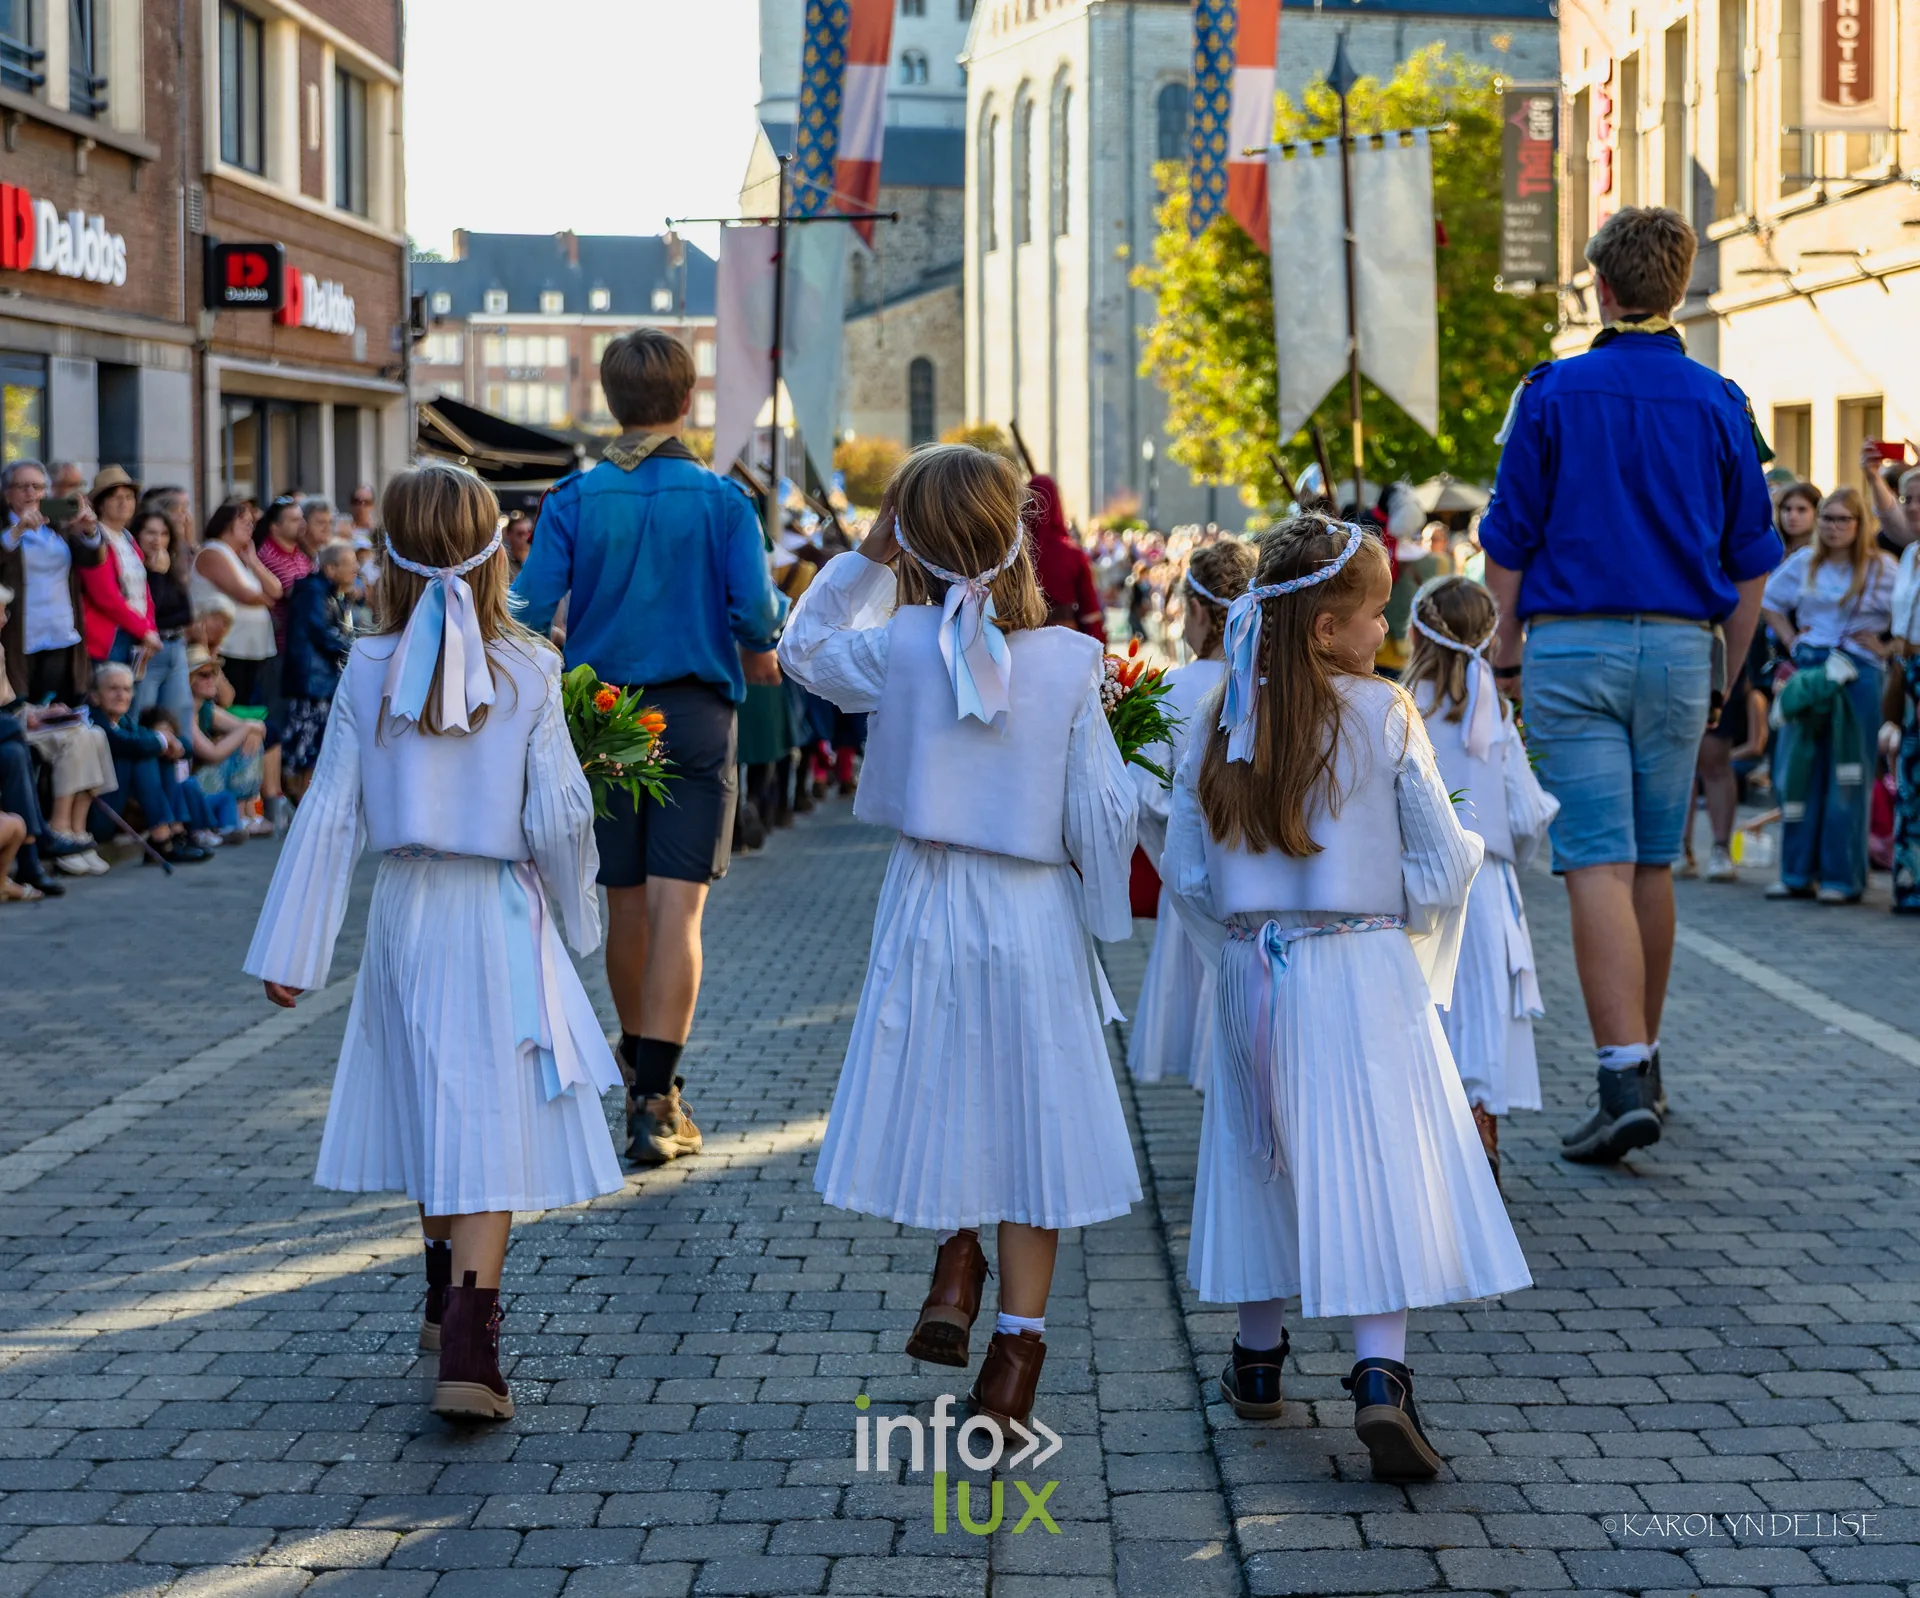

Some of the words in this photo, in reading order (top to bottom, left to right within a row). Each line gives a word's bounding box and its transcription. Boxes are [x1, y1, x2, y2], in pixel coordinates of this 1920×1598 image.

[1836, 0, 1860, 107] HOTEL
[32, 198, 127, 287] DaJobs
[301, 272, 355, 336] DaJobs
